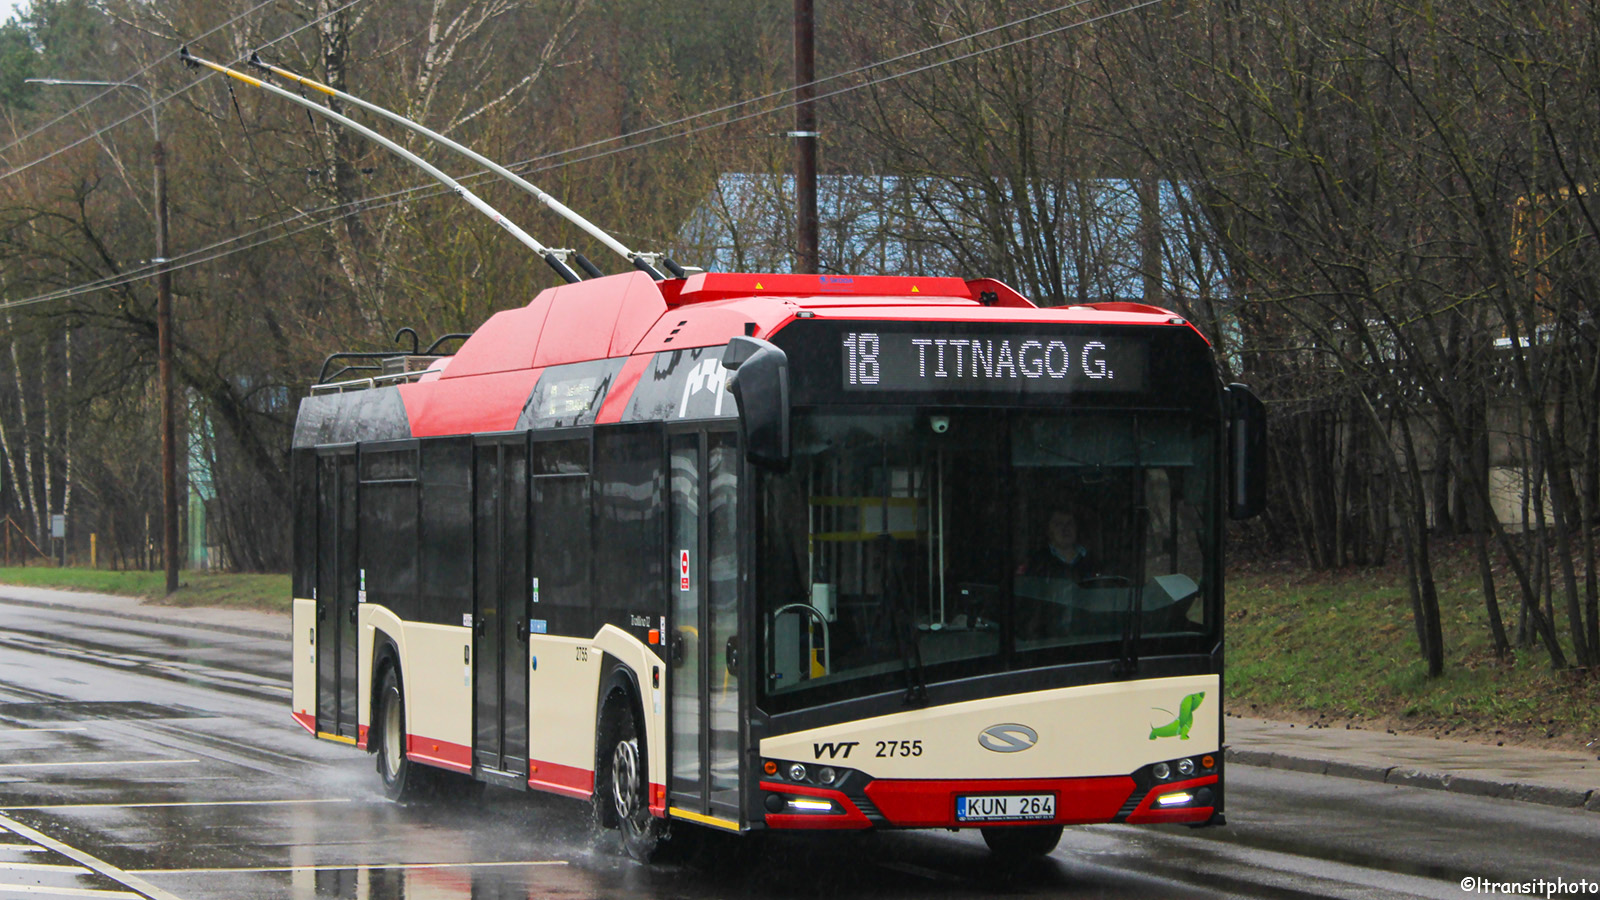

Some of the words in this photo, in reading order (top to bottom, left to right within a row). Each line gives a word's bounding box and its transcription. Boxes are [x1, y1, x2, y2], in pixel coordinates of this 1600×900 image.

[843, 332, 880, 385] 18
[911, 338, 1070, 379] TITNAGO
[1081, 340, 1114, 380] G.
[576, 646, 588, 662] 2755
[875, 740, 923, 758] 2755
[968, 798, 1007, 815] KUN
[1019, 797, 1052, 815] 264
